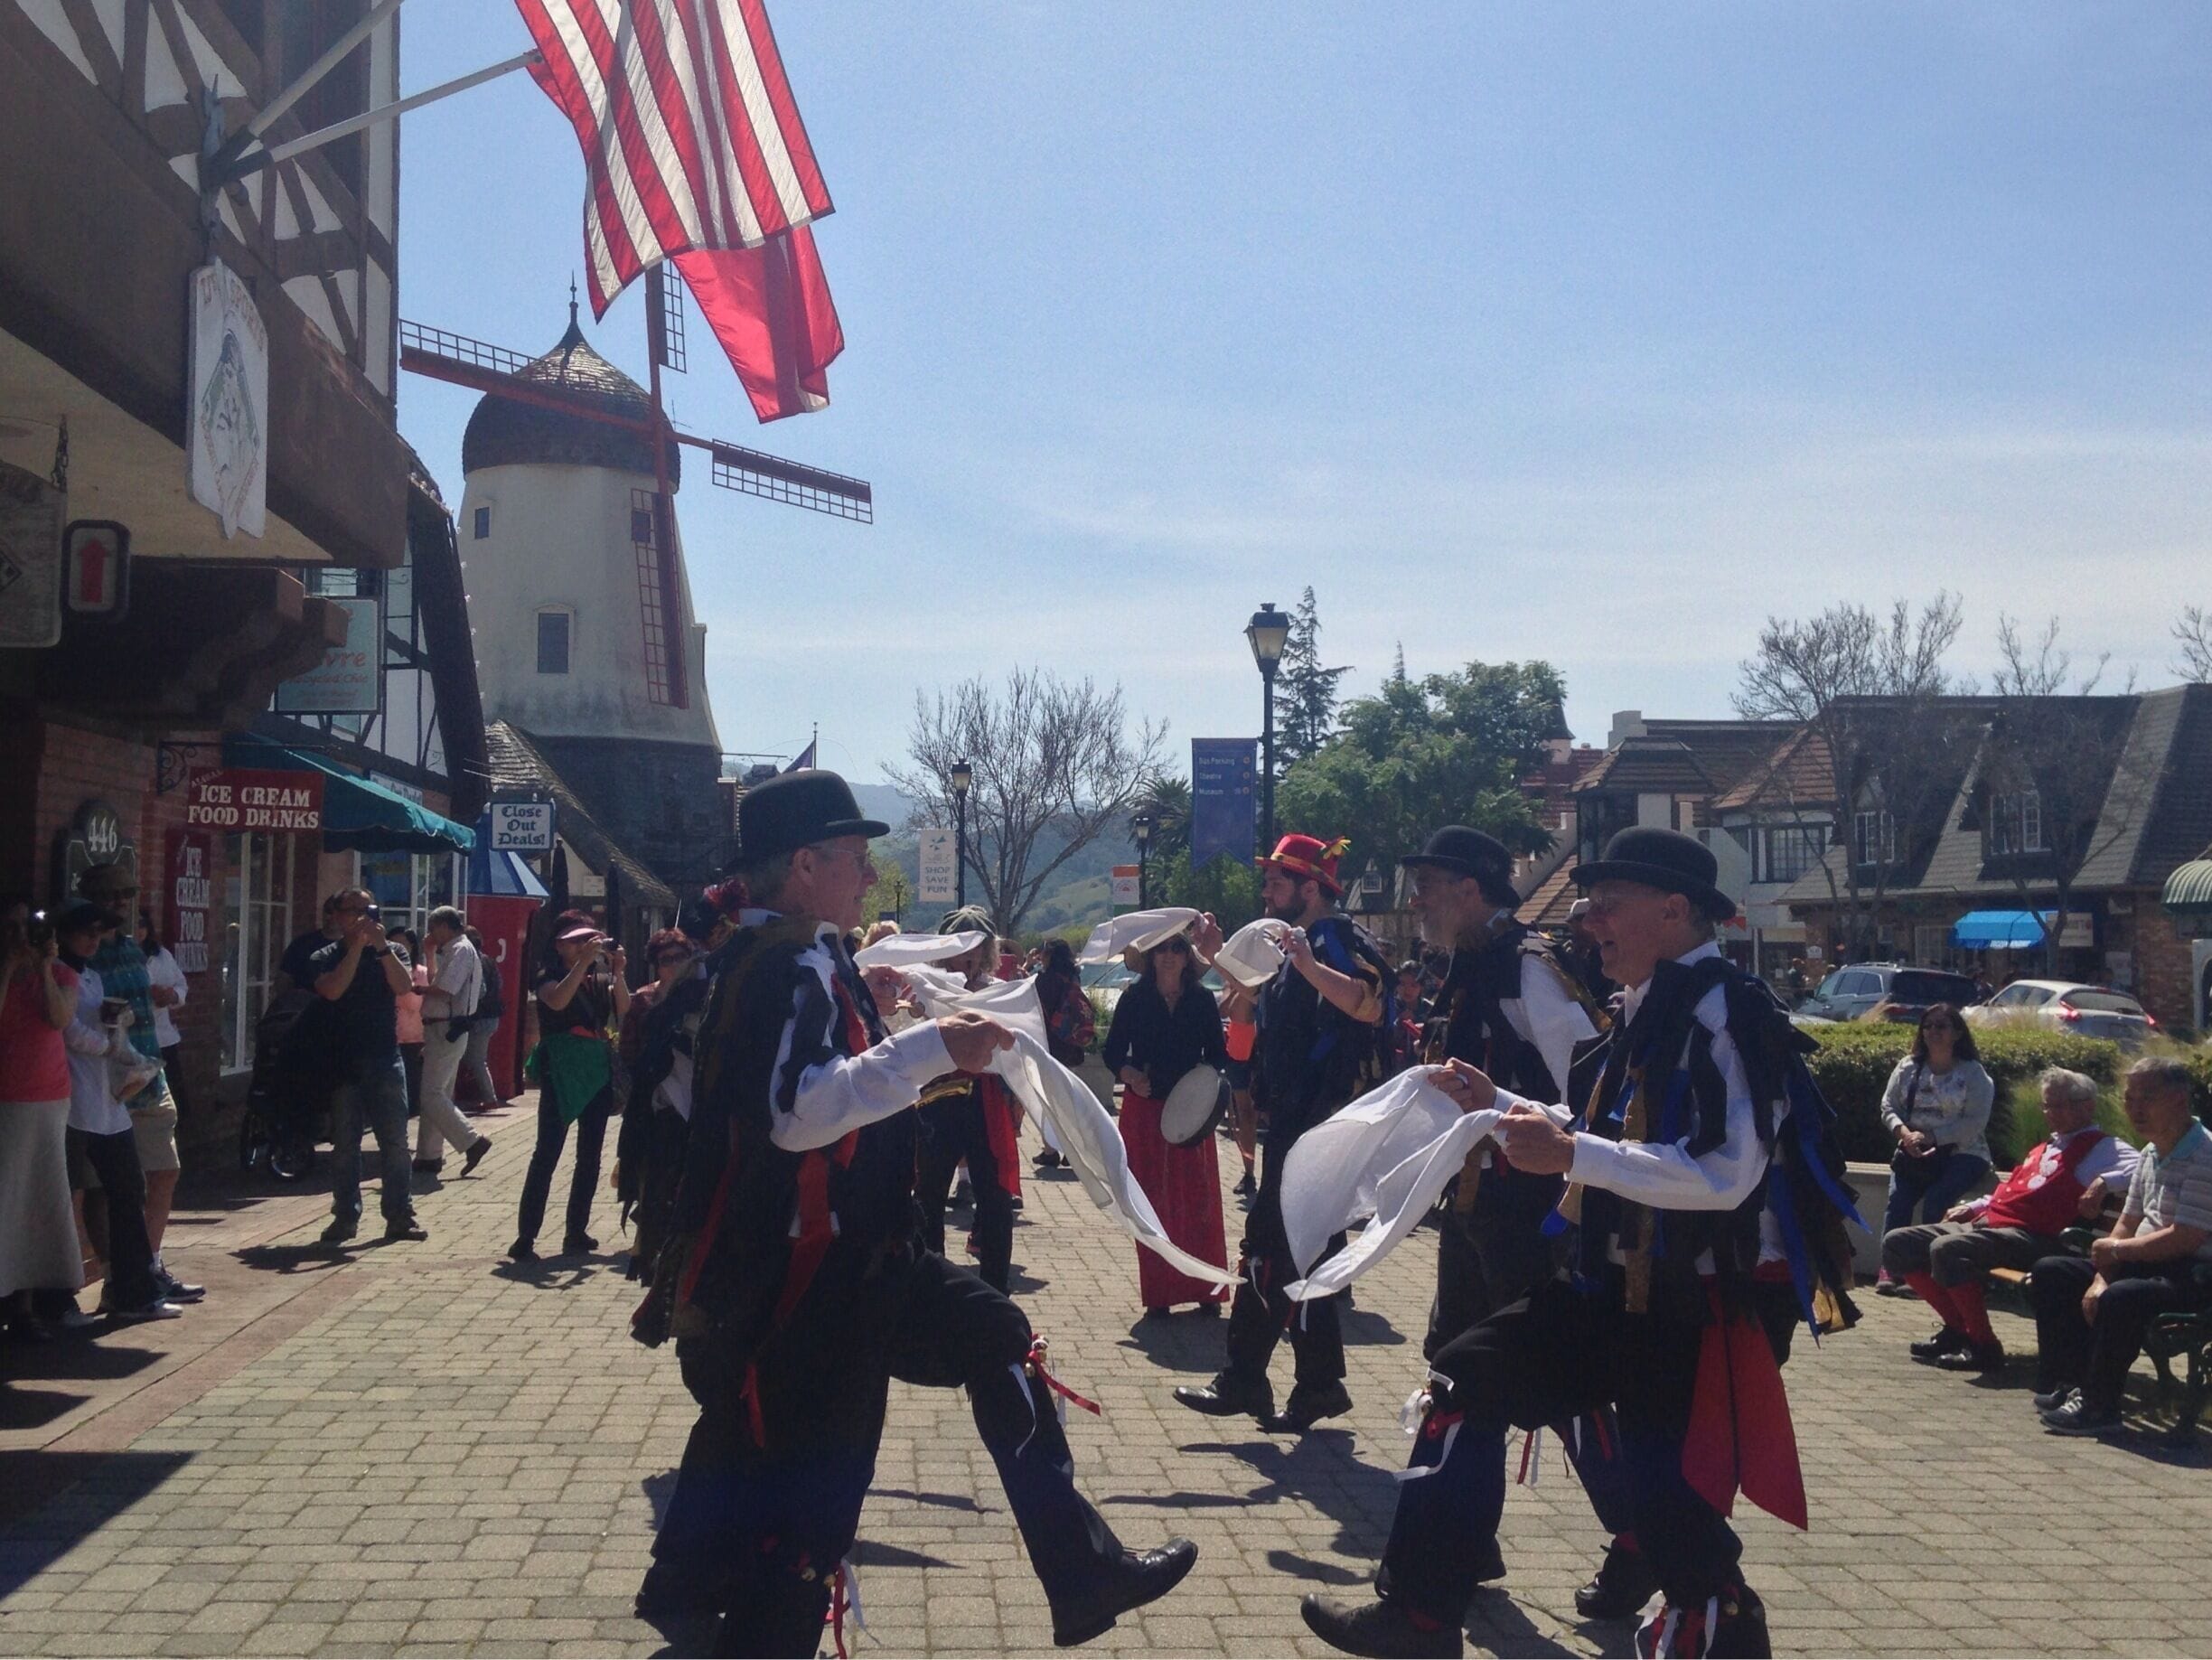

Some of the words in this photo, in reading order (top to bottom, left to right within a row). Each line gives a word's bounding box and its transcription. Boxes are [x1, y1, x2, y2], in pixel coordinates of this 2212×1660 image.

[199, 784, 232, 804] ICE
[240, 786, 311, 808] CREAM
[187, 805, 239, 826] FOOD
[245, 808, 319, 830] DRINKS
[501, 805, 542, 818] Close
[88, 816, 118, 853] 446
[507, 819, 537, 831] Out
[185, 847, 202, 877] ICE
[925, 866, 951, 874] SHOP
[925, 876, 948, 884] SAVE
[927, 886, 947, 894] FUN
[175, 877, 211, 908] CREAM
[179, 910, 204, 942] FOOD
[173, 942, 209, 973] DRINKS
